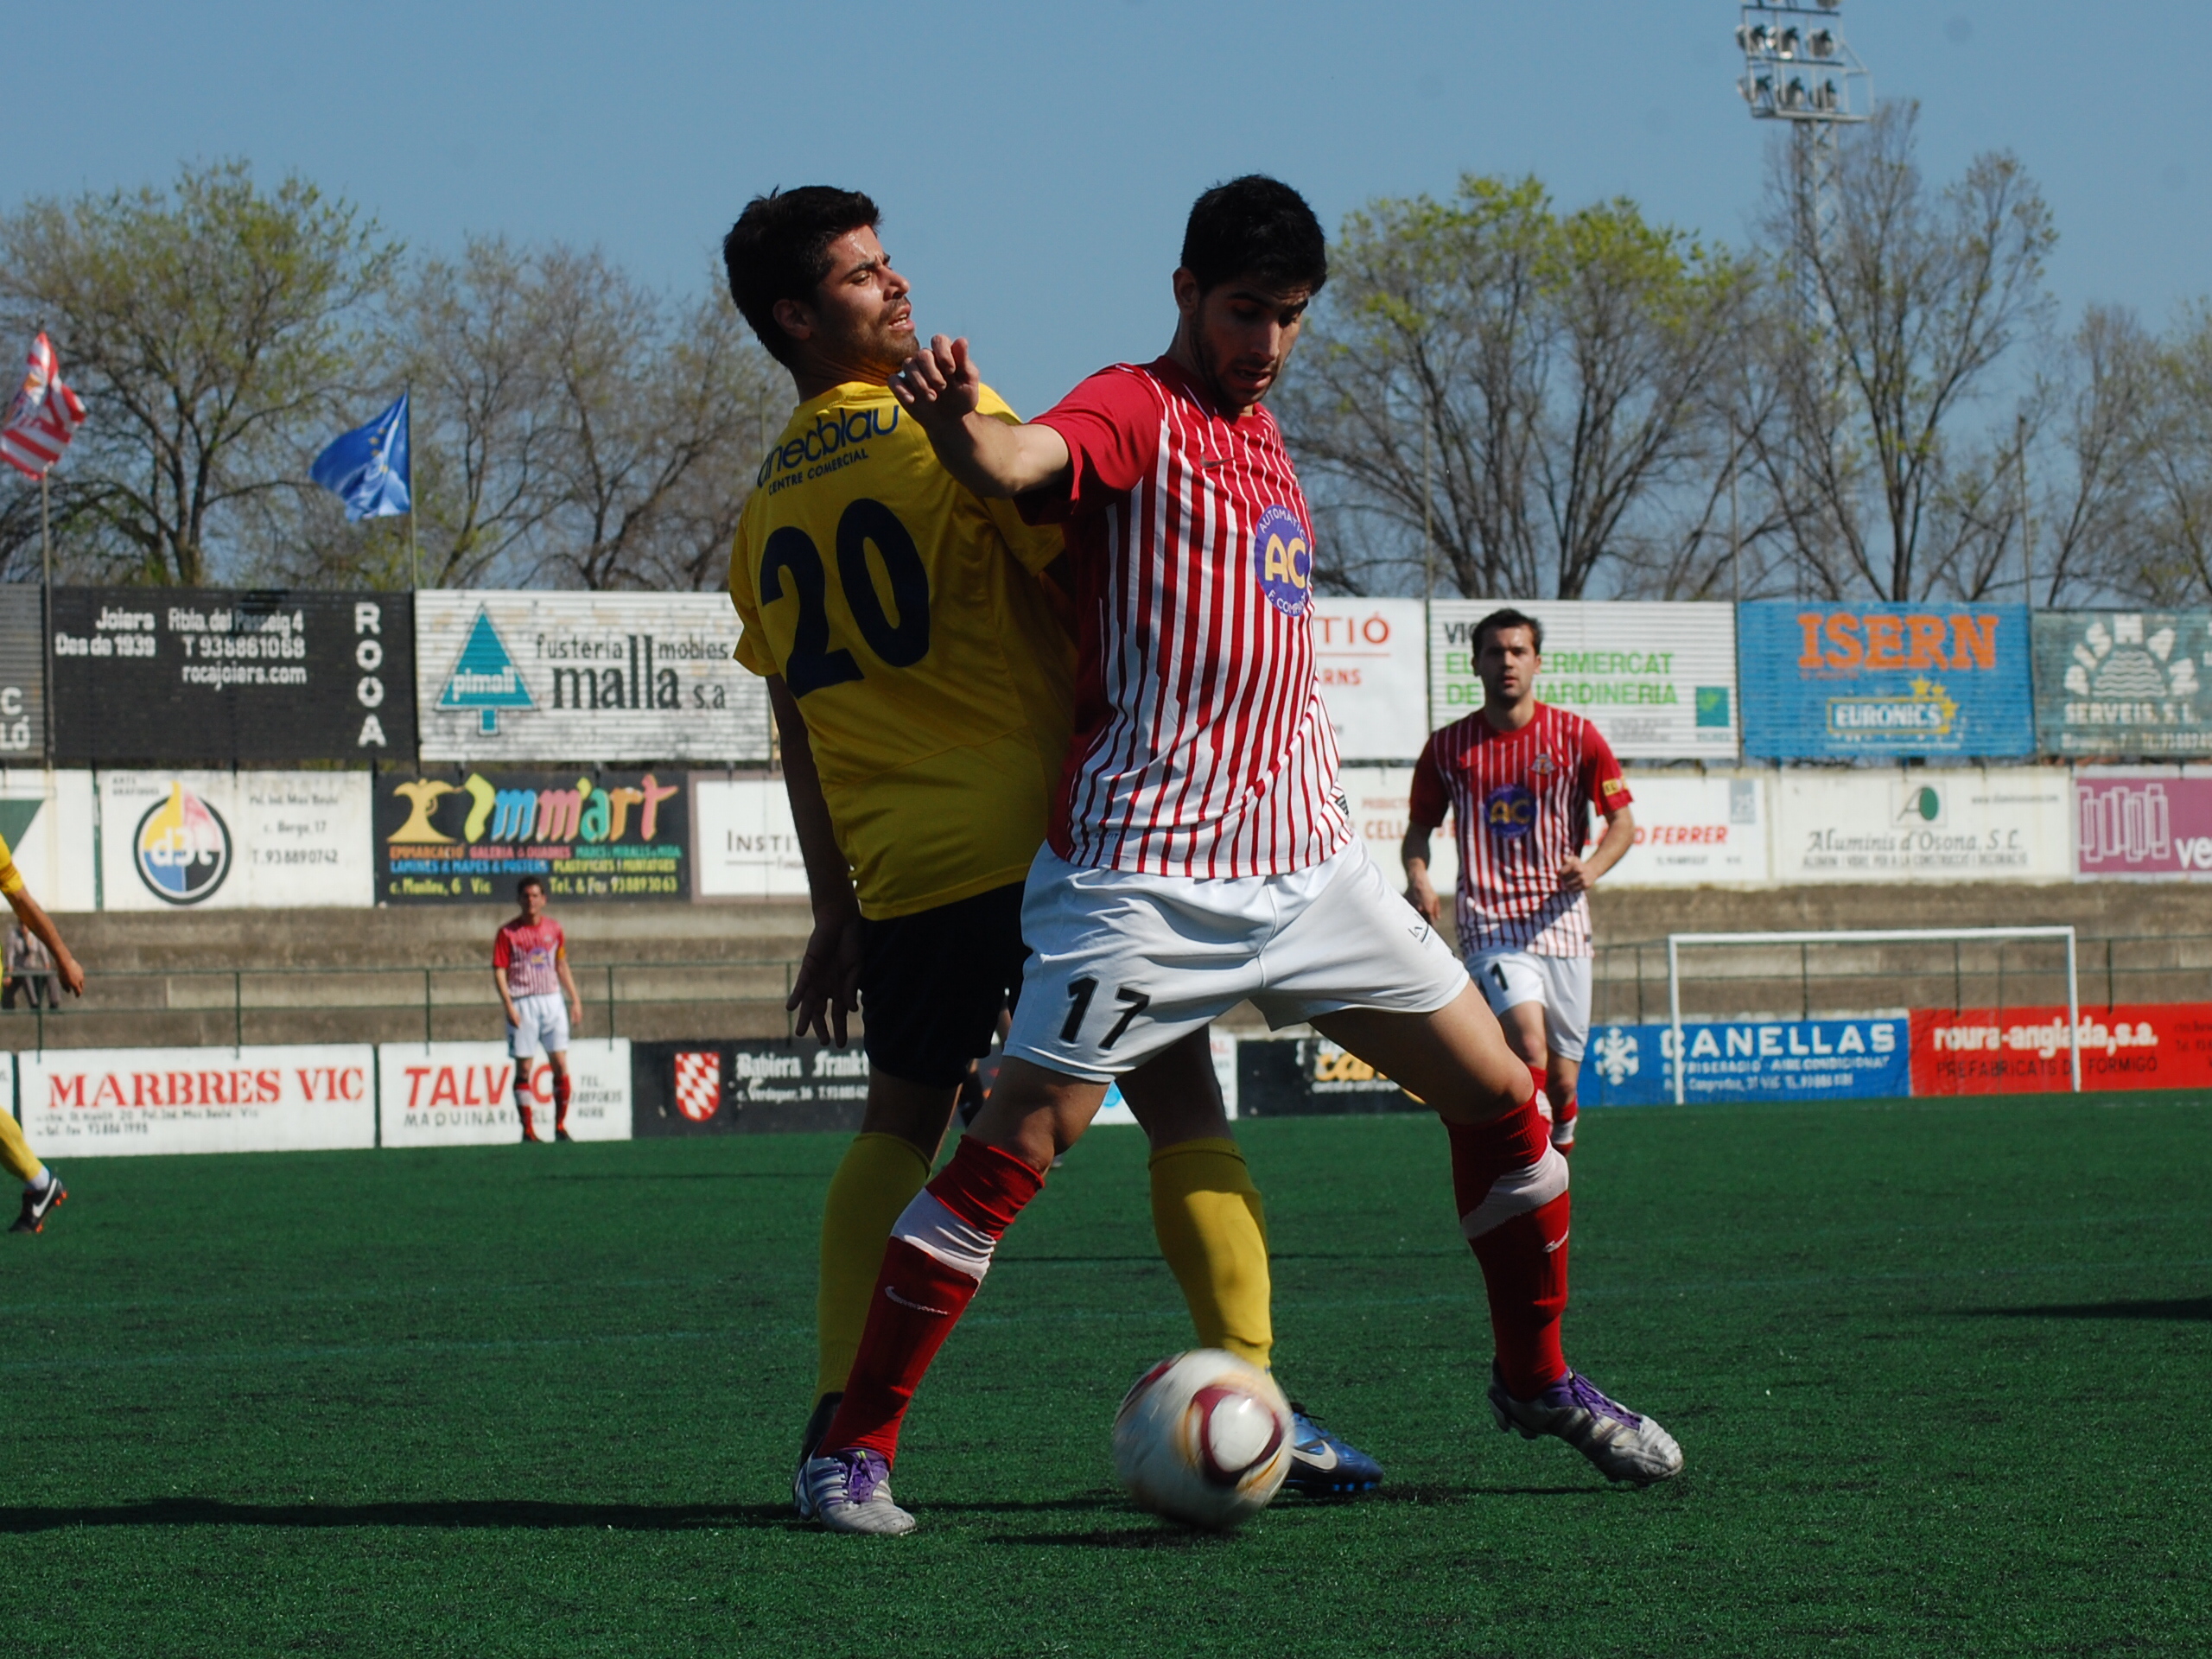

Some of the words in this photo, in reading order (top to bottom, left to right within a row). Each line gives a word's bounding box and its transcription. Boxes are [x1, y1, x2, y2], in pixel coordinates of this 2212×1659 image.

[768, 471, 804, 497] CENTRE
[807, 448, 869, 480] COMERCIAL
[1259, 507, 1306, 540] AUTOMATIC
[1264, 532, 1306, 589] AC
[760, 498, 931, 700] 20
[95, 606, 156, 632] Joiers
[209, 607, 232, 632] del
[292, 608, 304, 633] 4
[1313, 612, 1390, 645] TIÓ
[90, 632, 112, 657] de
[114, 632, 156, 658] 1939
[182, 633, 195, 658] T
[535, 634, 624, 658] fusteria
[658, 635, 729, 660] mobles
[1796, 612, 1999, 671] ISERN
[182, 659, 307, 690] rocajoiers.com
[551, 635, 683, 709] malla
[1539, 652, 1675, 675] ERMERCAT
[1324, 668, 1362, 686] RNS
[1446, 683, 1481, 705] DE
[1835, 702, 1942, 728] EURONICS
[1489, 798, 1532, 824] AC
[727, 830, 798, 852] INSTI
[1364, 819, 1407, 840] CELL
[1649, 825, 1728, 846] FERRER
[469, 845, 514, 859] GALERIA
[2174, 837, 2212, 869] ve
[450, 877, 461, 895] 6
[1058, 975, 1151, 1051] 17
[1659, 1023, 1897, 1058] CANELLAS
[1662, 1057, 1764, 1075] RRIGERACIÓ
[1936, 1059, 2057, 1079] PREFABRICATS
[2088, 1052, 2158, 1074] FORMIGÓ
[48, 1069, 281, 1108] MARBRES
[296, 1066, 364, 1102] VIC
[405, 1065, 553, 1108] TALVC
[404, 1109, 516, 1128] MAQUINARI
